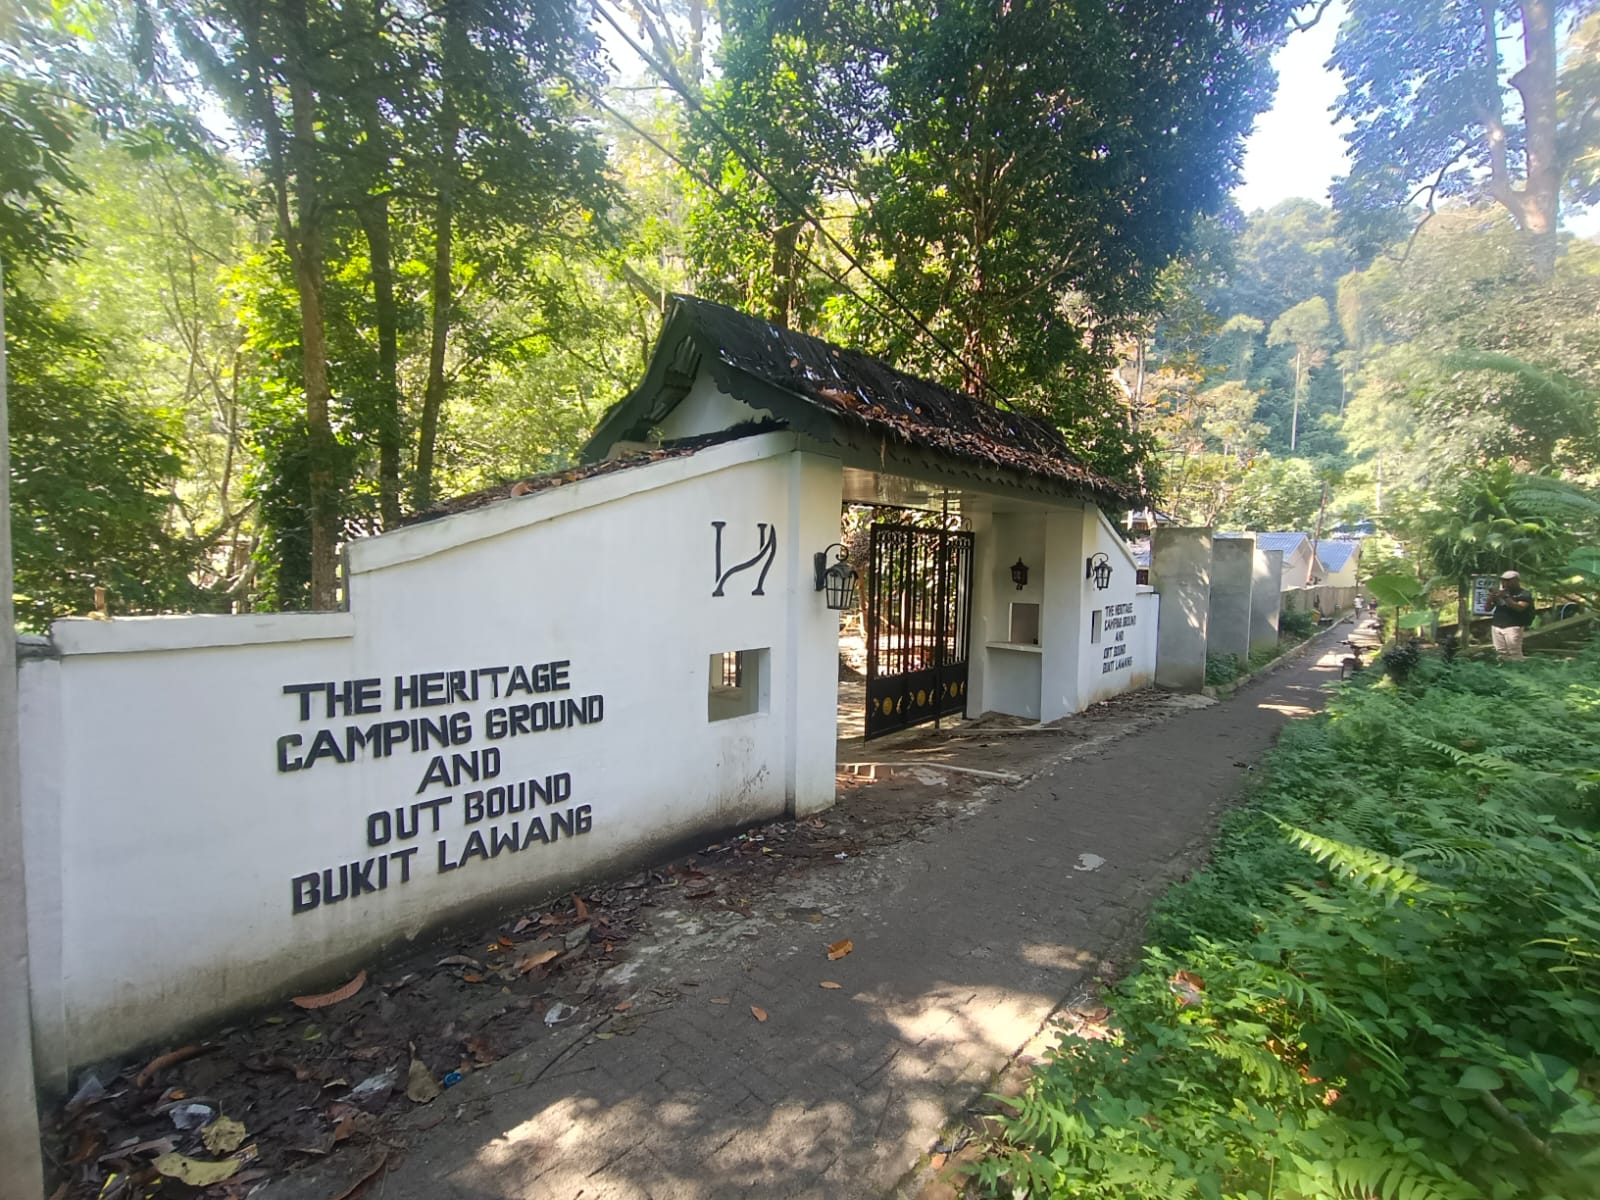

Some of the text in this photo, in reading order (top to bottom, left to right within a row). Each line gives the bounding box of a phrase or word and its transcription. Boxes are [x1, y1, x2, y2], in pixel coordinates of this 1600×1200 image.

[282, 660, 571, 721] THE HERITAGE
[276, 694, 605, 773] CAMPING GROUND
[417, 747, 501, 794] AND
[367, 772, 572, 848] OUT BOUND
[291, 804, 593, 915] BUKIT LAWANG
